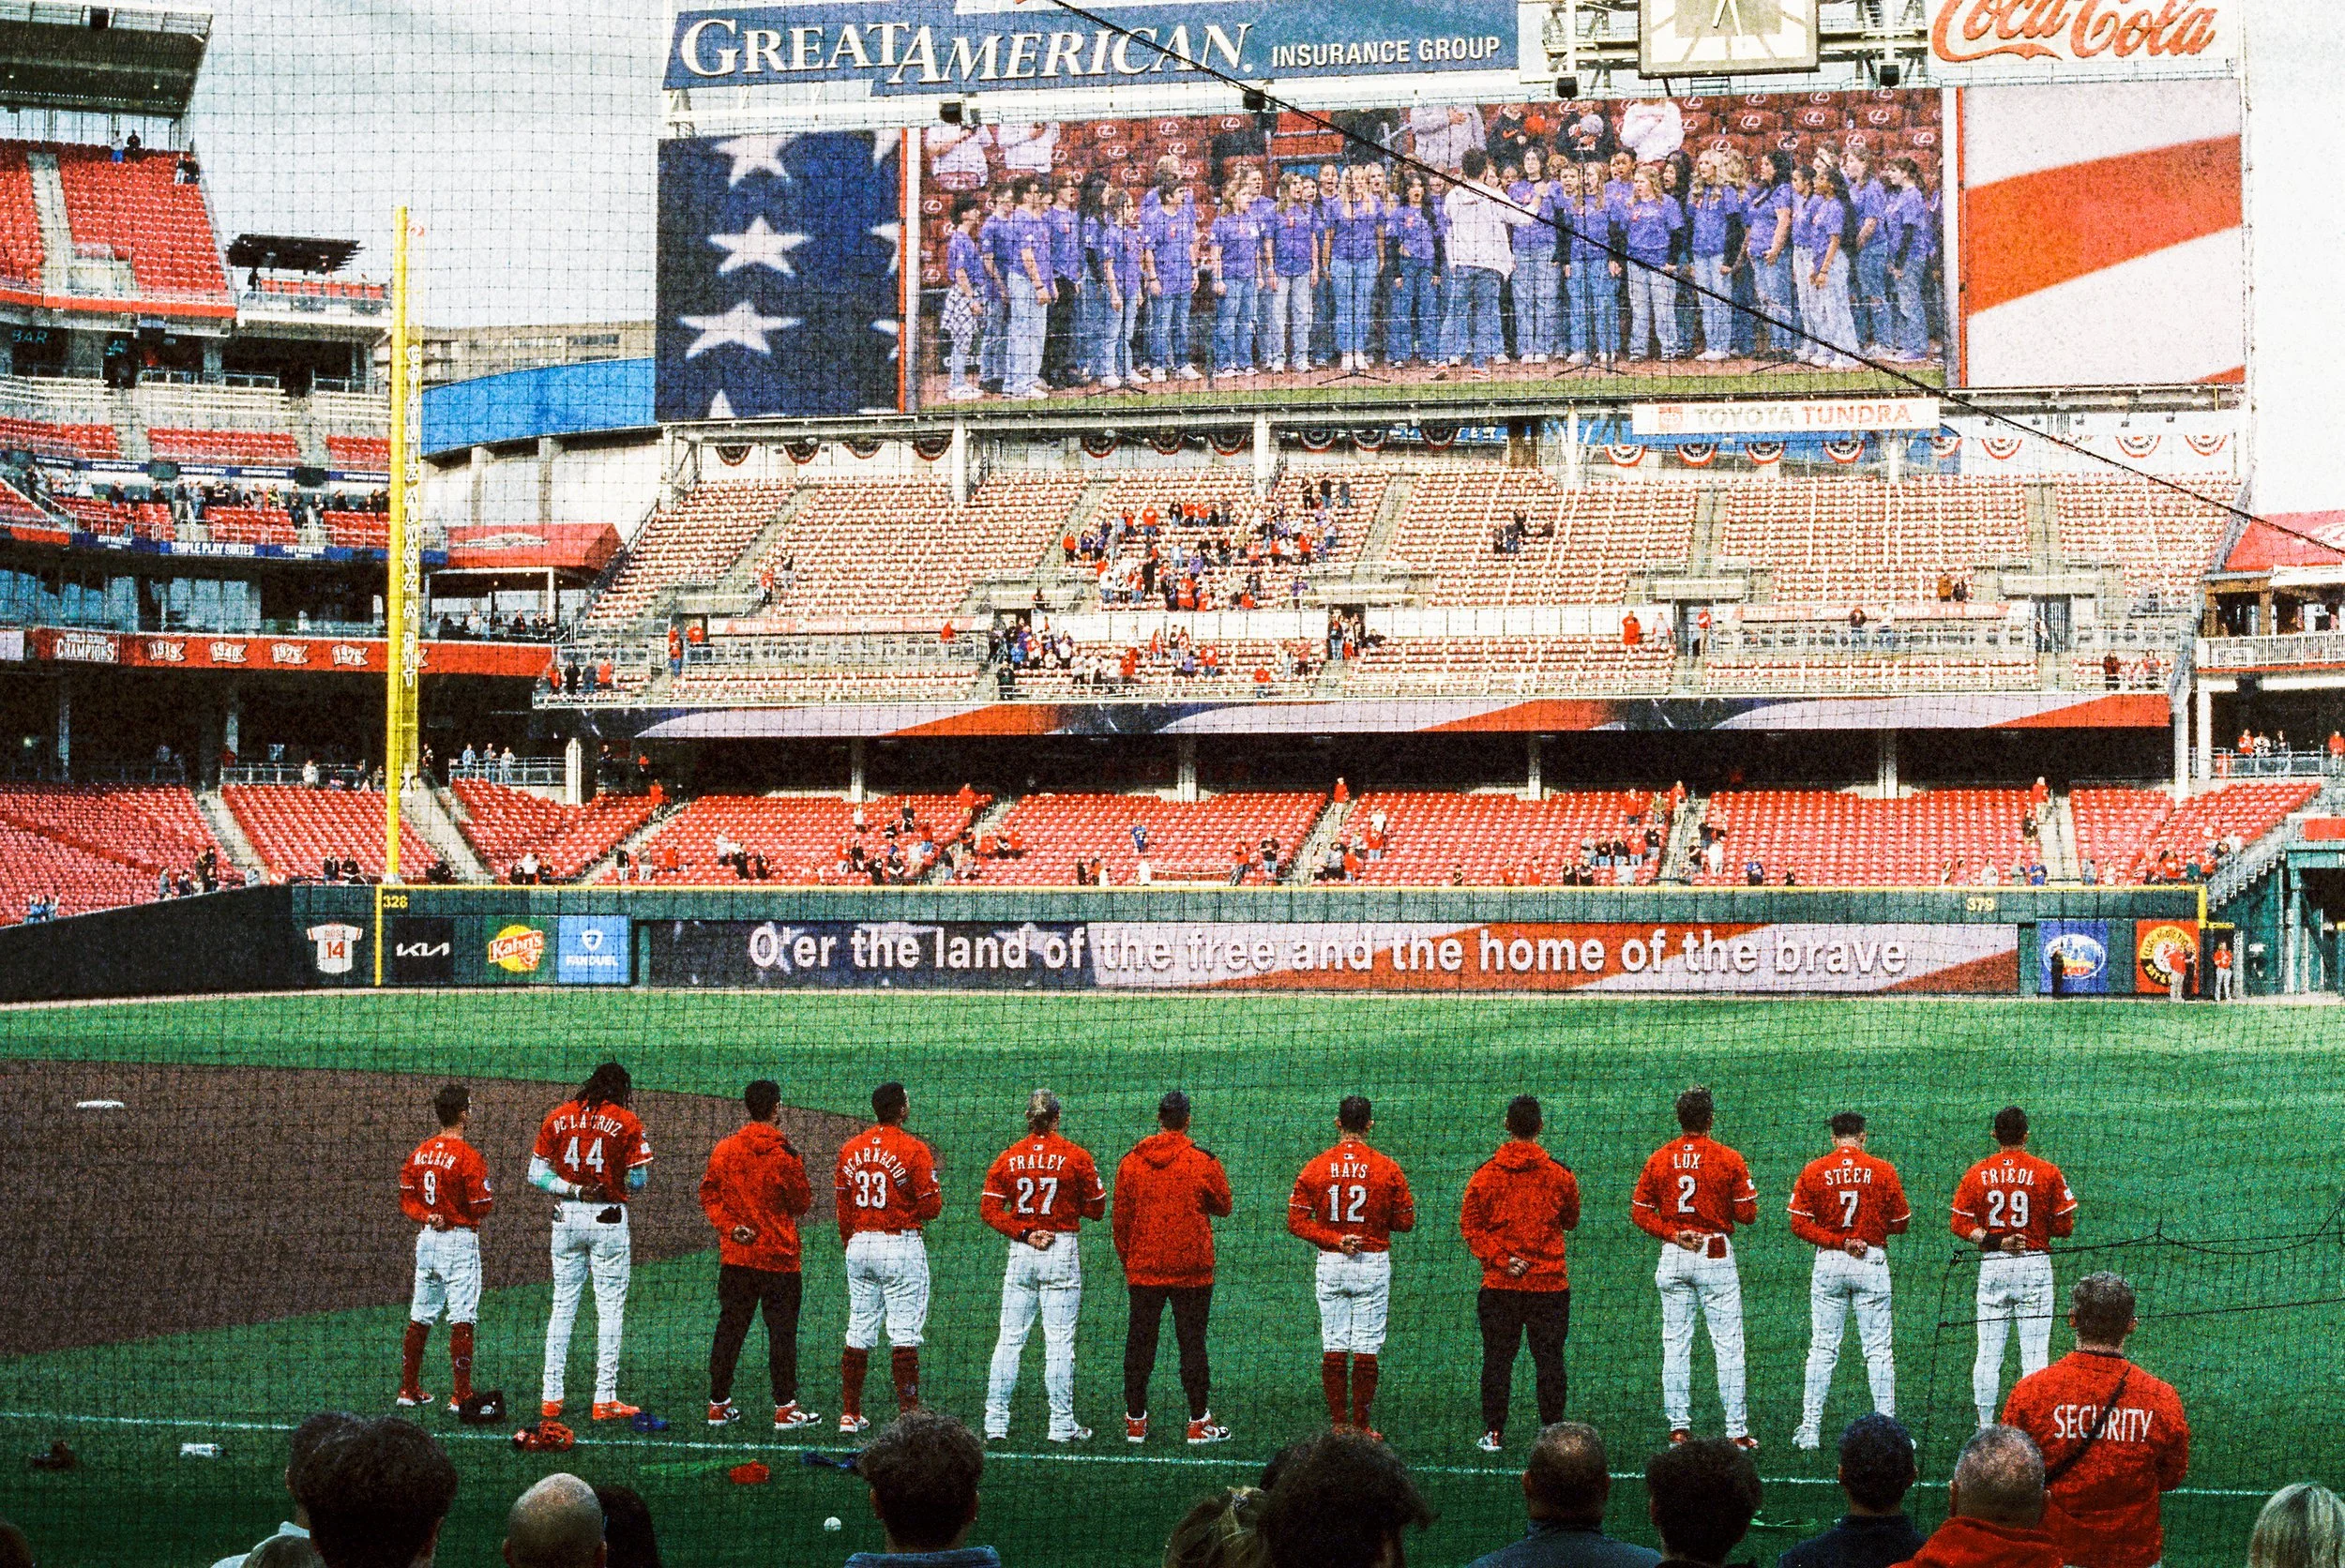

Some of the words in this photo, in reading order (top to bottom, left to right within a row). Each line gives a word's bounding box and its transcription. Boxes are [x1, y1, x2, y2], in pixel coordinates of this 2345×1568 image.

[681, 19, 910, 77] GREAT
[1273, 40, 1410, 67] INSURANCE
[1418, 36, 1500, 62] GROUP
[1694, 405, 1794, 428] TOYOTA
[1801, 403, 1913, 425] TUNDRA
[202, 543, 223, 555] PLAY
[225, 544, 255, 556] SUITES
[57, 639, 114, 661] CHAMPIONS
[383, 895, 408, 909] 328
[1967, 897, 1995, 911] 379
[326, 941, 344, 959] 14
[490, 931, 544, 958] Kahn's
[750, 926, 836, 969] O'er
[850, 927, 920, 969] the
[935, 927, 1027, 969] land
[1044, 927, 1088, 969] of
[1101, 927, 1172, 971] the
[1188, 927, 1276, 971] free
[1292, 928, 1374, 972] and
[1390, 928, 1463, 972] the
[1479, 928, 1605, 972] home
[1622, 928, 1667, 972] of
[1683, 928, 1758, 972] the
[1775, 929, 1907, 973] brave
[566, 956, 618, 967] FANDUEL
[553, 1116, 567, 1135] DE
[570, 1114, 587, 1129] LA
[590, 1115, 623, 1137] CRUZ
[564, 1137, 604, 1172] 44
[1008, 1153, 1067, 1172] FRALEY
[1673, 1153, 1701, 1169] LUX
[1330, 1162, 1368, 1179] HAYS
[1823, 1167, 1872, 1186] STEER
[1980, 1168, 2035, 1186] FRIEDL
[423, 1170, 436, 1206] 9
[855, 1170, 887, 1209] 33
[1017, 1177, 1057, 1214] 27
[1677, 1175, 1696, 1214] 2
[1327, 1184, 1367, 1223] 12
[1839, 1190, 1859, 1229] 7
[1987, 1190, 2030, 1229] 29
[2053, 1404, 2154, 1442] SECURITY
